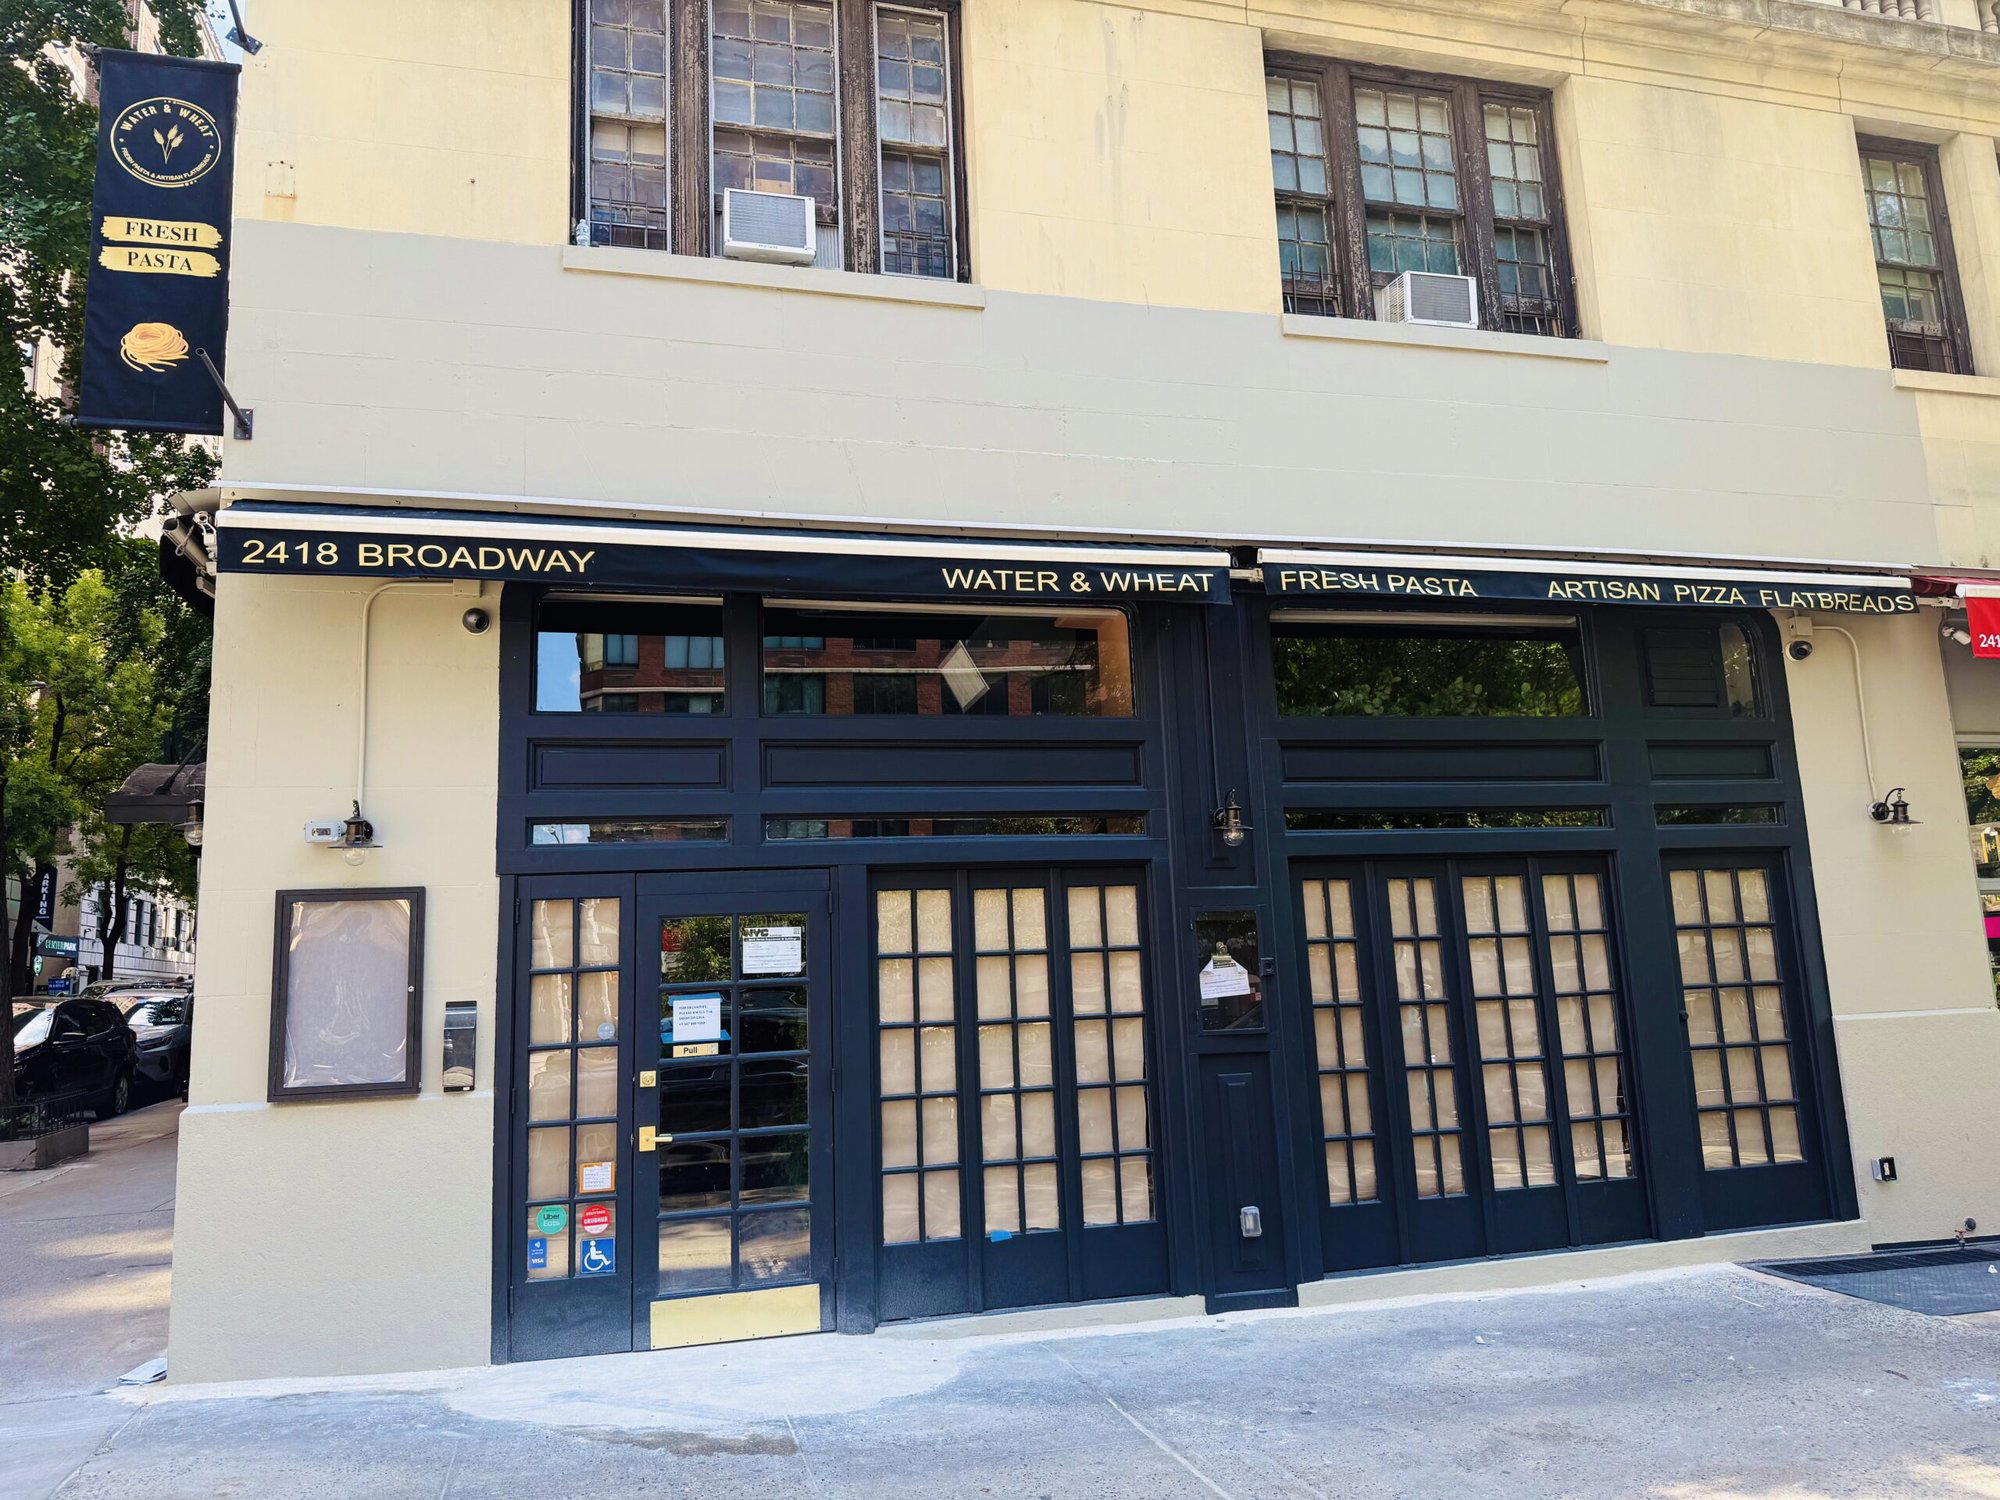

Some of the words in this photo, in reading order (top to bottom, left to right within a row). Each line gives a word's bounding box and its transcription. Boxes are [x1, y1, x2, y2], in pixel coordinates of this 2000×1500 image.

[120, 105, 158, 131] WATER
[163, 104, 171, 113] &
[179, 107, 214, 137] WHEAT
[132, 162, 150, 176] PASTA
[125, 221, 198, 242] FRESH
[127, 251, 193, 271] PASTA
[241, 539, 339, 566] 2418
[358, 543, 596, 574] BROADWAY
[941, 567, 1060, 593] WATER
[1070, 571, 1092, 593] &
[1100, 570, 1214, 594] WHEAT
[1280, 570, 1379, 592] FRESH
[1387, 574, 1479, 598] PASTA
[1547, 579, 1660, 602] ARTISAN
[1674, 584, 1747, 605] PIZZA
[1759, 589, 1915, 613] FLATBREADS
[39, 872, 50, 915] ARKING
[683, 1046, 698, 1055] Pull
[543, 1213, 560, 1221] Uber
